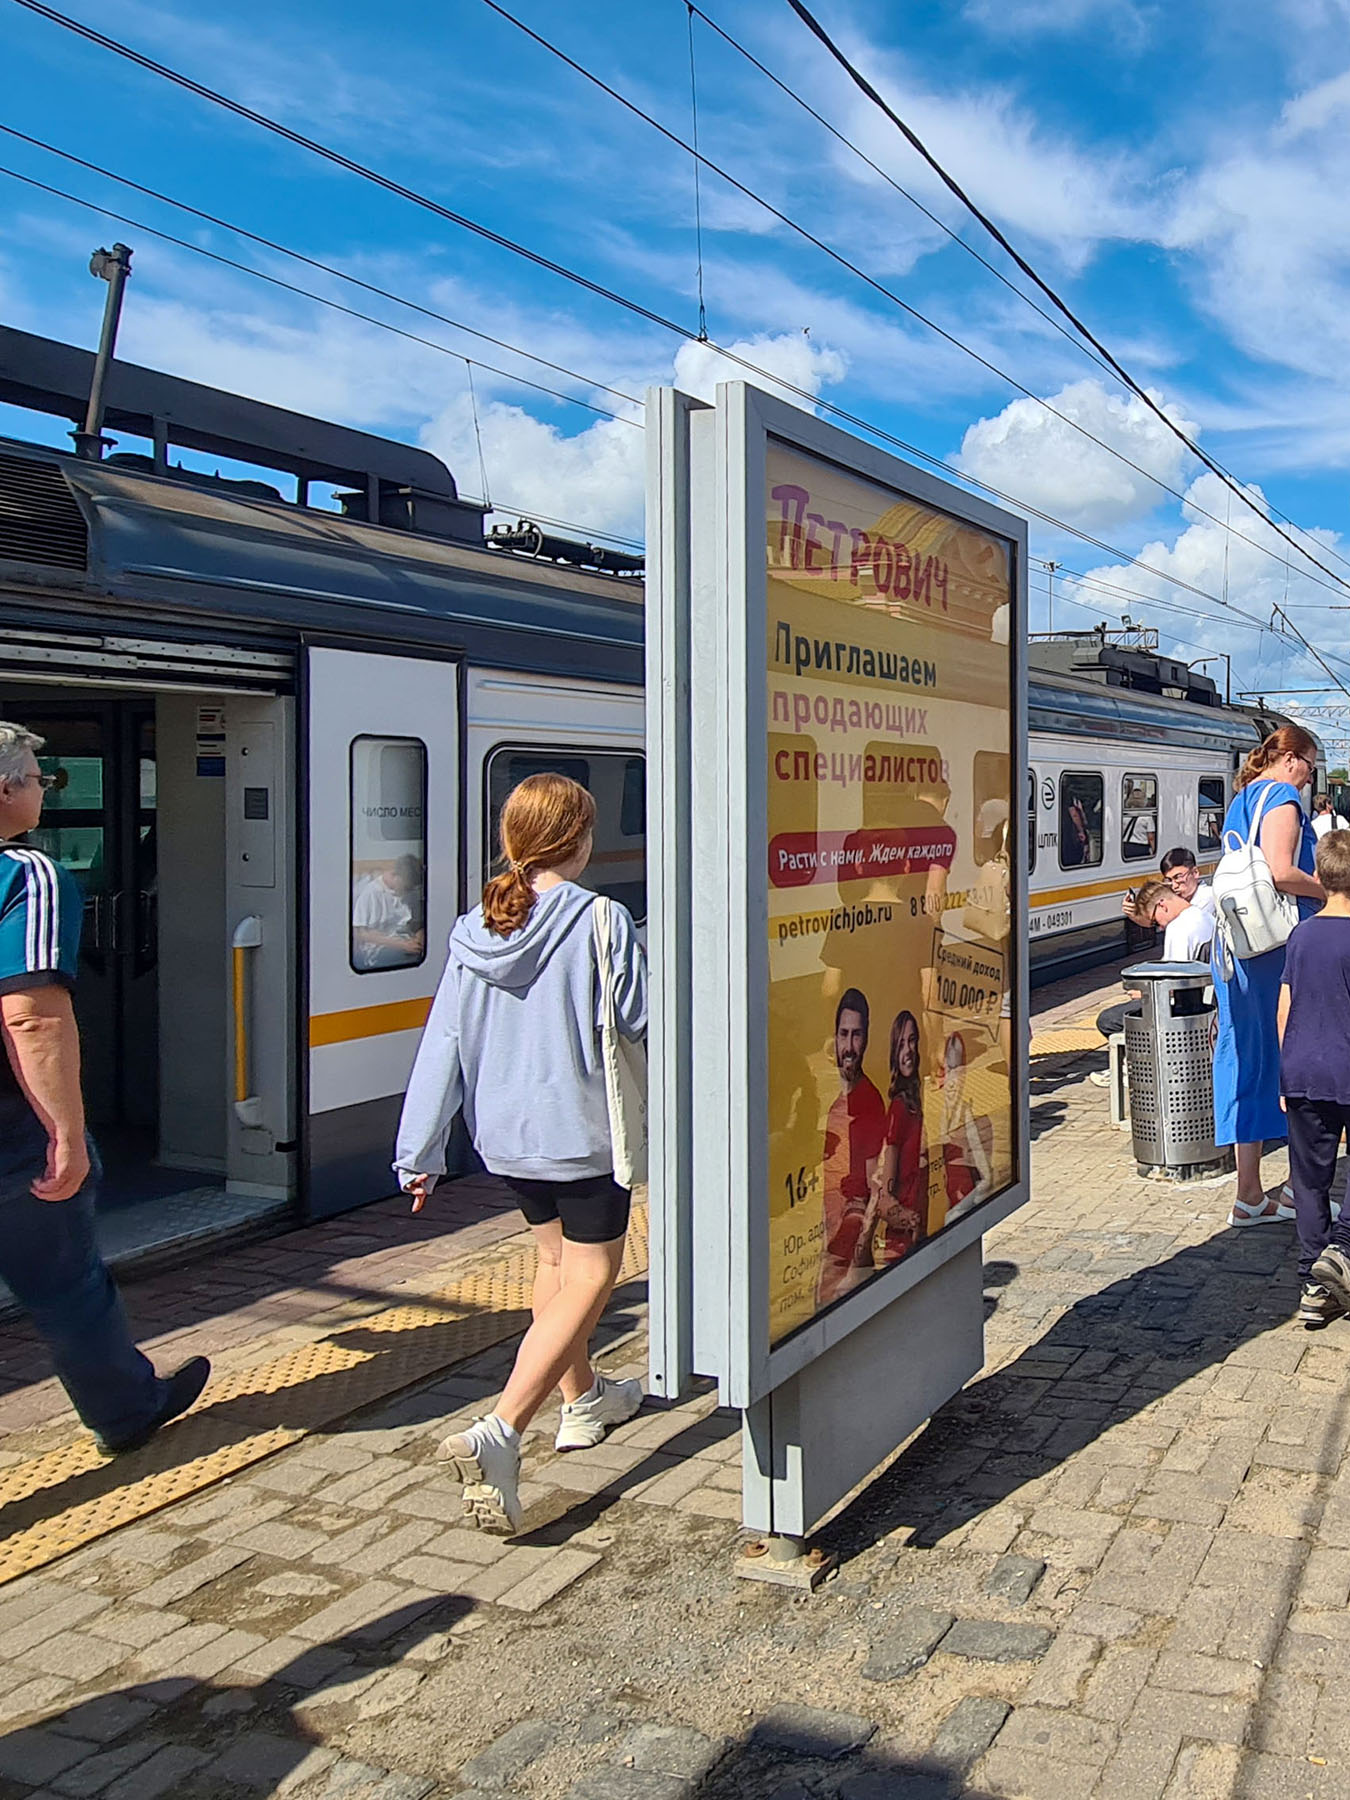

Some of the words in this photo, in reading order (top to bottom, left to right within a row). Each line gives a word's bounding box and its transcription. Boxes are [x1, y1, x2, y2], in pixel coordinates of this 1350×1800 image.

[775, 620, 937, 688] Приглашаем
[772, 690, 928, 738] продающих
[774, 750, 950, 789] специалистов
[362, 806, 398, 818] ЧИСЛО
[400, 806, 422, 818] МЕС
[778, 849, 817, 871] Расти
[820, 852, 827, 866] с
[830, 849, 866, 867] нами.
[868, 843, 906, 864] Ждем
[907, 843, 953, 861] каждого
[778, 903, 892, 947] petrovichjob.ru
[910, 896, 918, 916] 8
[937, 944, 972, 971] Средний
[973, 961, 1000, 981] доход
[937, 975, 957, 1006] 100
[960, 984, 985, 1014] 000
[785, 1166, 819, 1208] 16+
